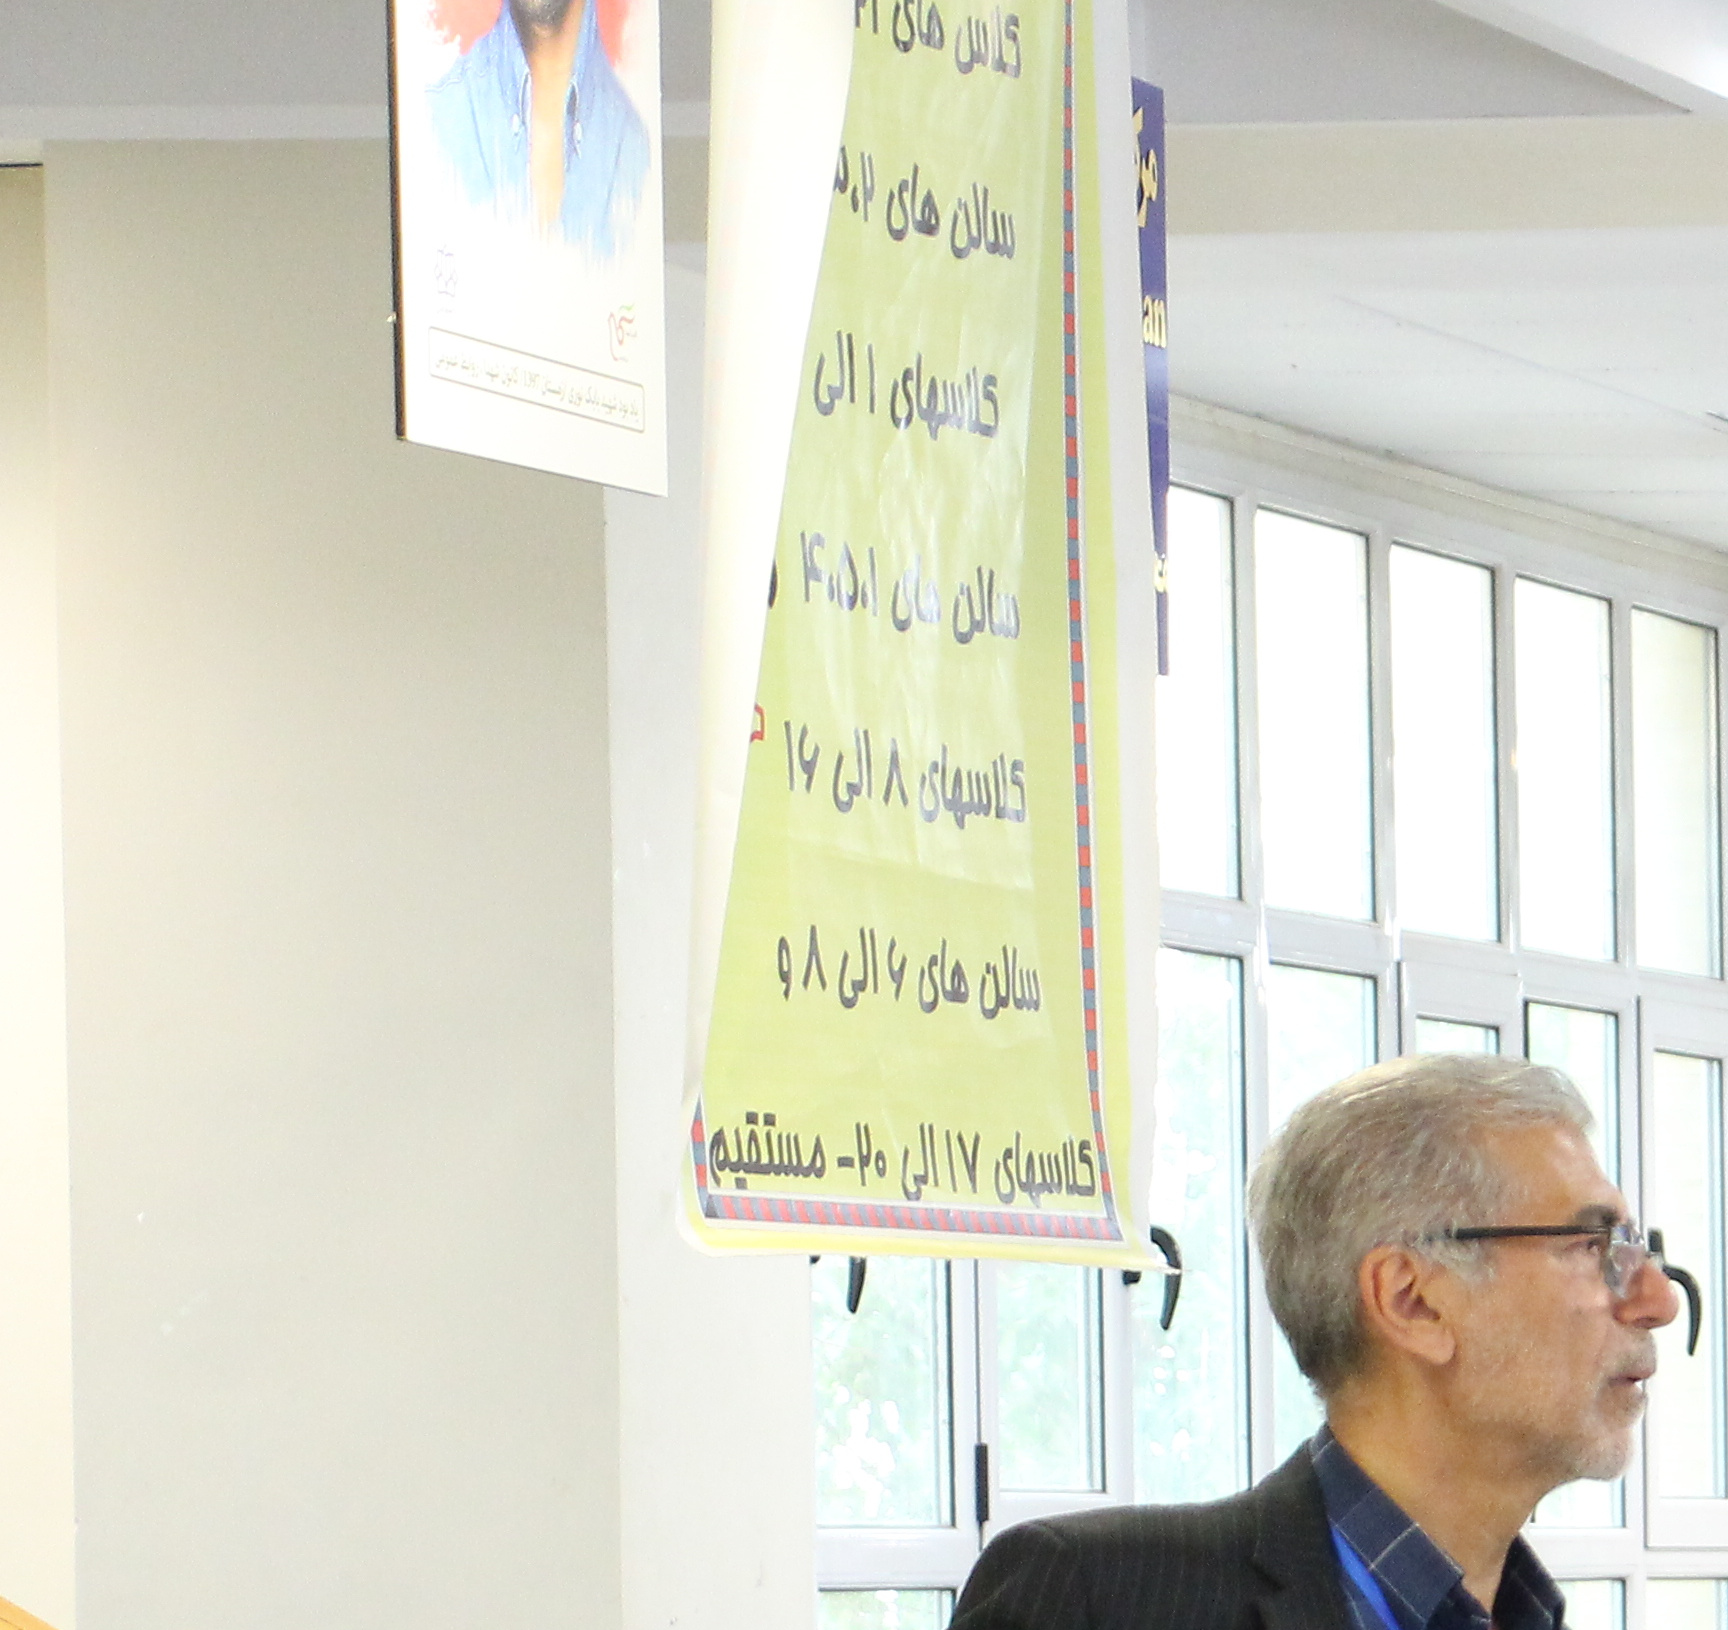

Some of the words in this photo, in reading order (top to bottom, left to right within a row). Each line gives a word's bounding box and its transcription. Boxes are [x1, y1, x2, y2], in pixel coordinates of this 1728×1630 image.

[955, 4, 1021, 78] کلاس
[886, 162, 941, 241] های
[950, 181, 1015, 260] سالن
[814, 330, 856, 416] الی
[891, 352, 999, 441] کلاسهای
[891, 551, 941, 632] های
[953, 565, 1020, 644] سالن
[784, 720, 820, 794] ۱۶
[832, 726, 873, 813] الی
[884, 737, 909, 808] ۸
[919, 743, 1026, 830] کلاسهای
[802, 924, 827, 992] ۸
[838, 926, 878, 1009] الی
[887, 936, 908, 1001] ۶
[917, 937, 969, 1013] های
[979, 943, 1041, 1019] سالن
[709, 1111, 827, 1190] مستقیم
[901, 1122, 939, 1200] الی
[944, 1128, 980, 1193] ۱۷
[994, 1131, 1098, 1208] کلاسهای
